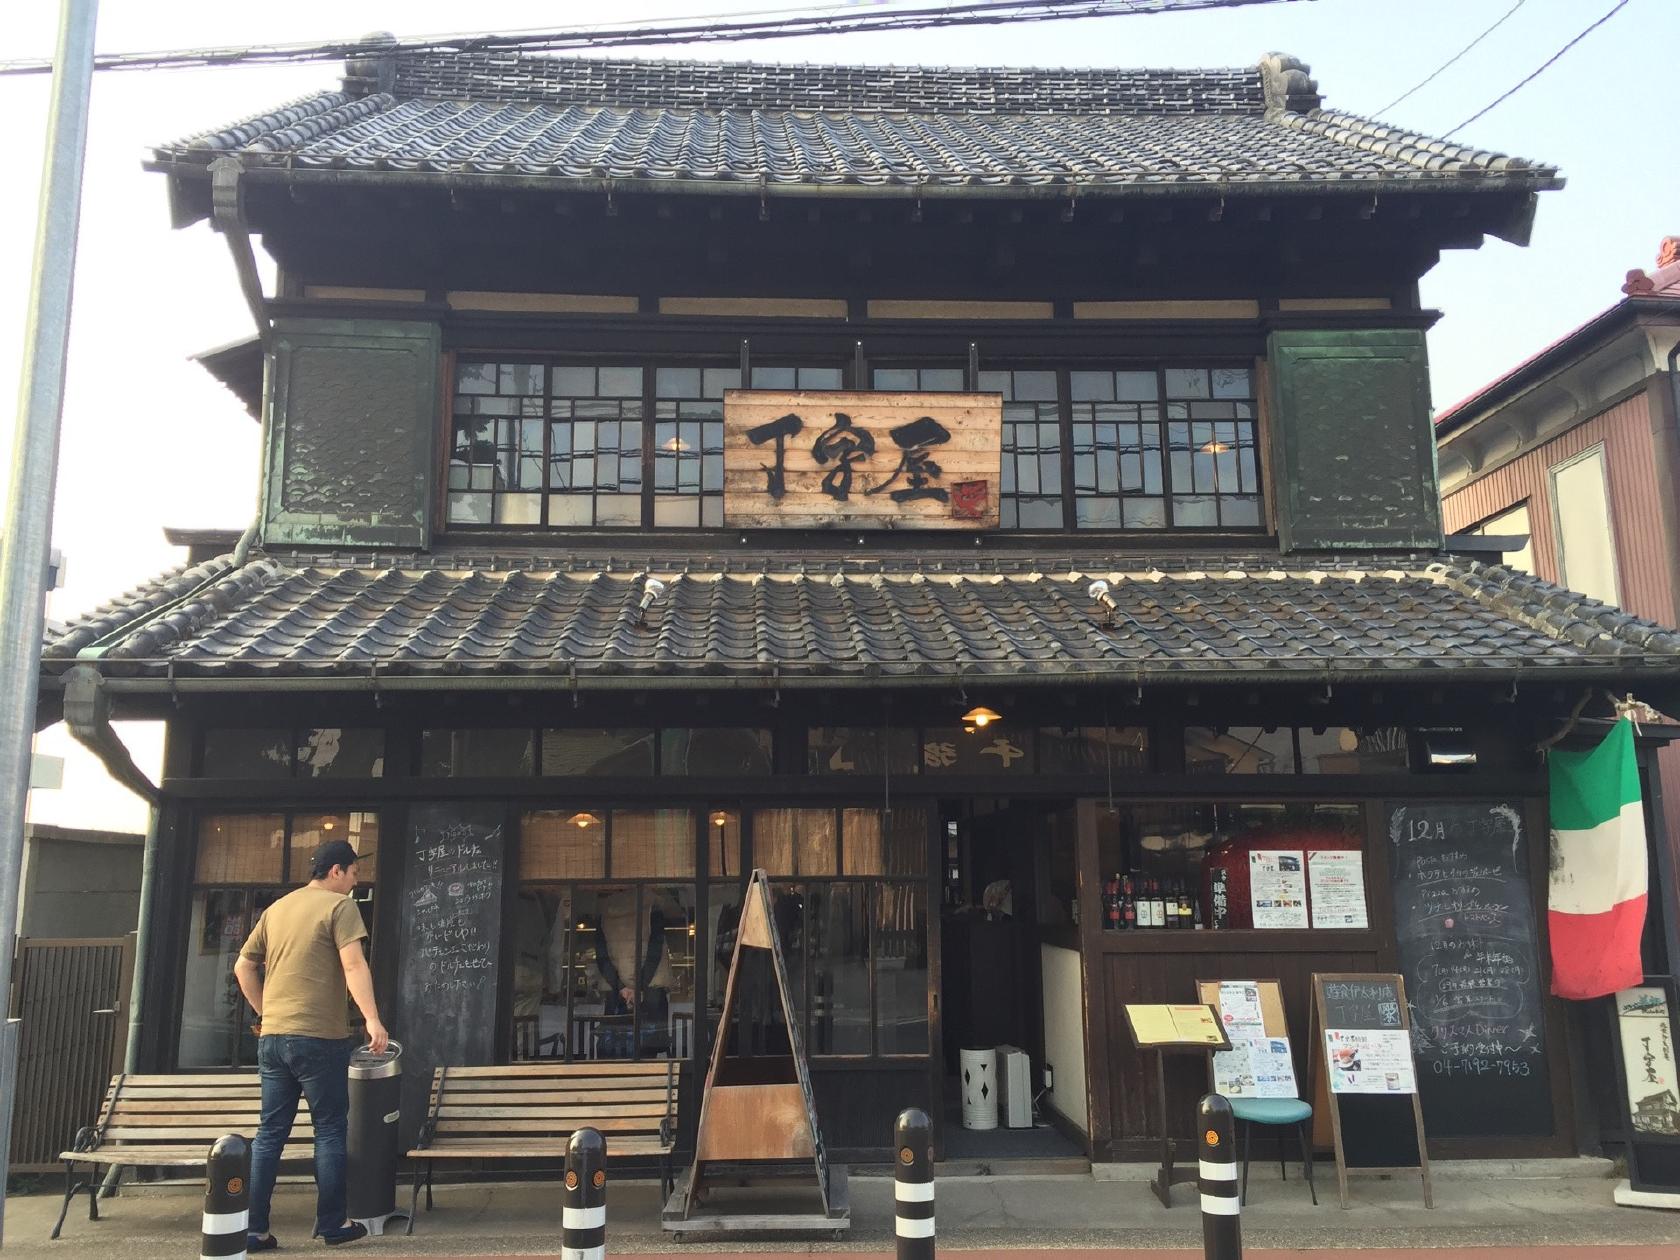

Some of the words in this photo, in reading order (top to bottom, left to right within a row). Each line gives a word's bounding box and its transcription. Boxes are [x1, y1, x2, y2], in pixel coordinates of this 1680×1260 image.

[746, 412, 951, 503] 丁字屋
[1408, 820, 1446, 842] 12月
[1639, 1036, 1660, 1084] 丁字屋
